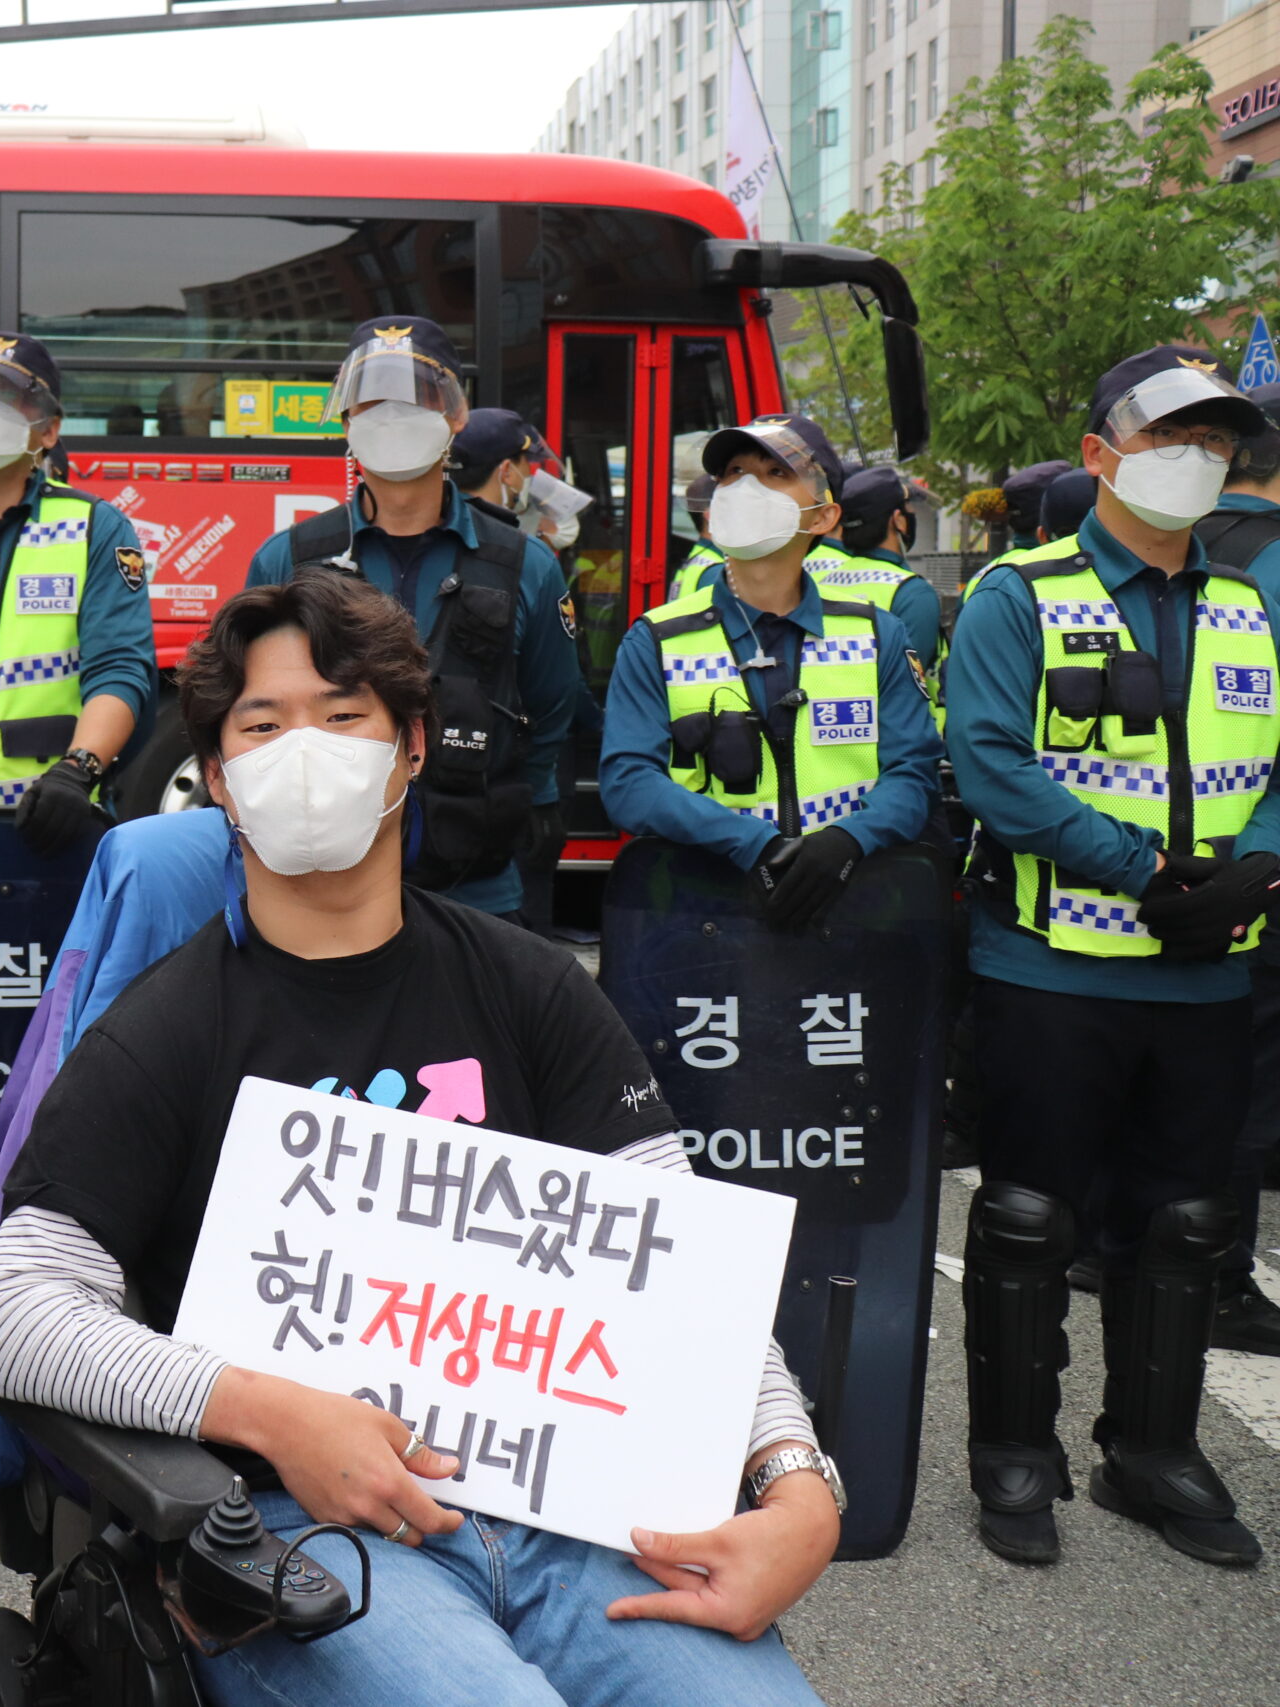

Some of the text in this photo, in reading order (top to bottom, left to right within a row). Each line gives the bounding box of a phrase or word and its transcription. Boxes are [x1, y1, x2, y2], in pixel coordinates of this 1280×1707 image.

[173, 513, 237, 575] 세종터미널
[22, 600, 71, 610] POLICE
[170, 607, 209, 618] Terminal
[1222, 694, 1270, 708] POLICE
[818, 727, 871, 739] POLICE
[442, 738, 487, 750] POLICE
[680, 1127, 865, 1170] POLICE
